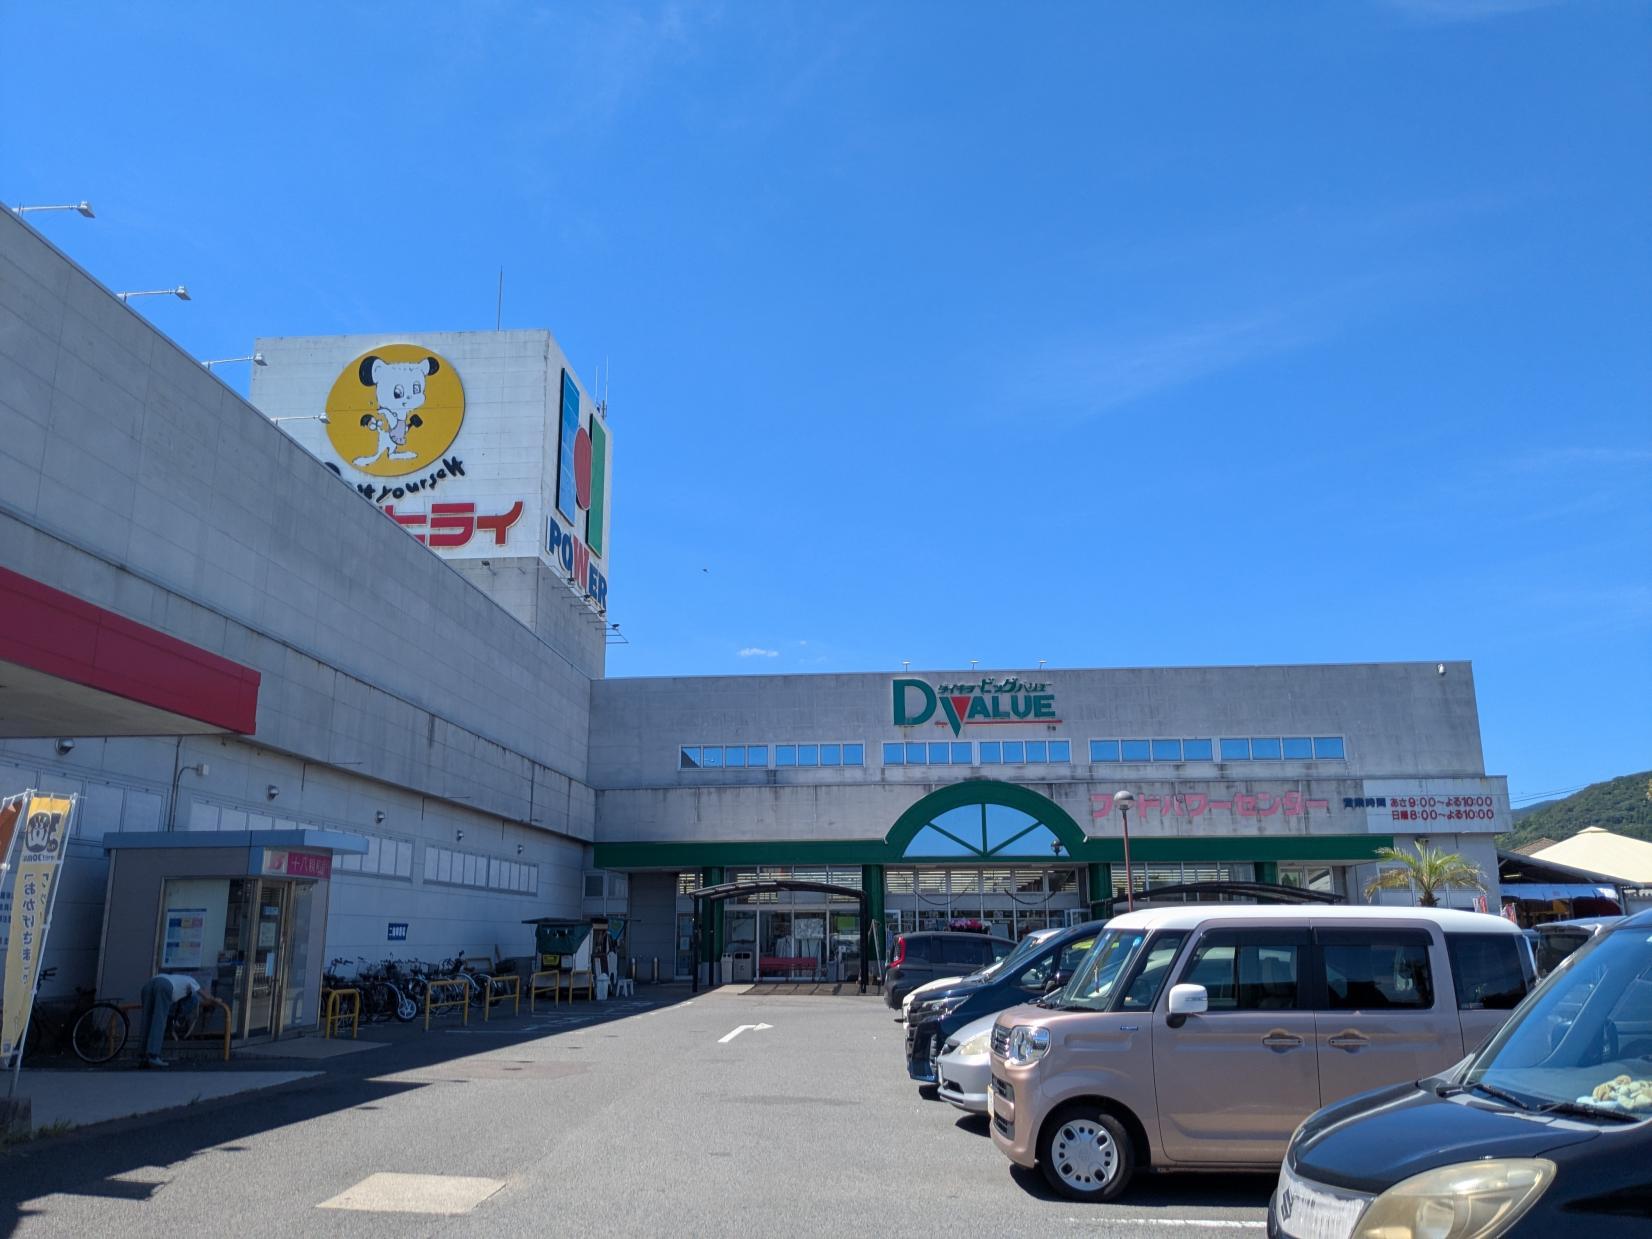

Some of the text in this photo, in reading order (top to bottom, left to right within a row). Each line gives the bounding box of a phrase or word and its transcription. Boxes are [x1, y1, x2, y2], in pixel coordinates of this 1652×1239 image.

[375, 456, 466, 503] yourself
[548, 516, 608, 613] POWER
[1091, 790, 1329, 818] フドパワーセンター
